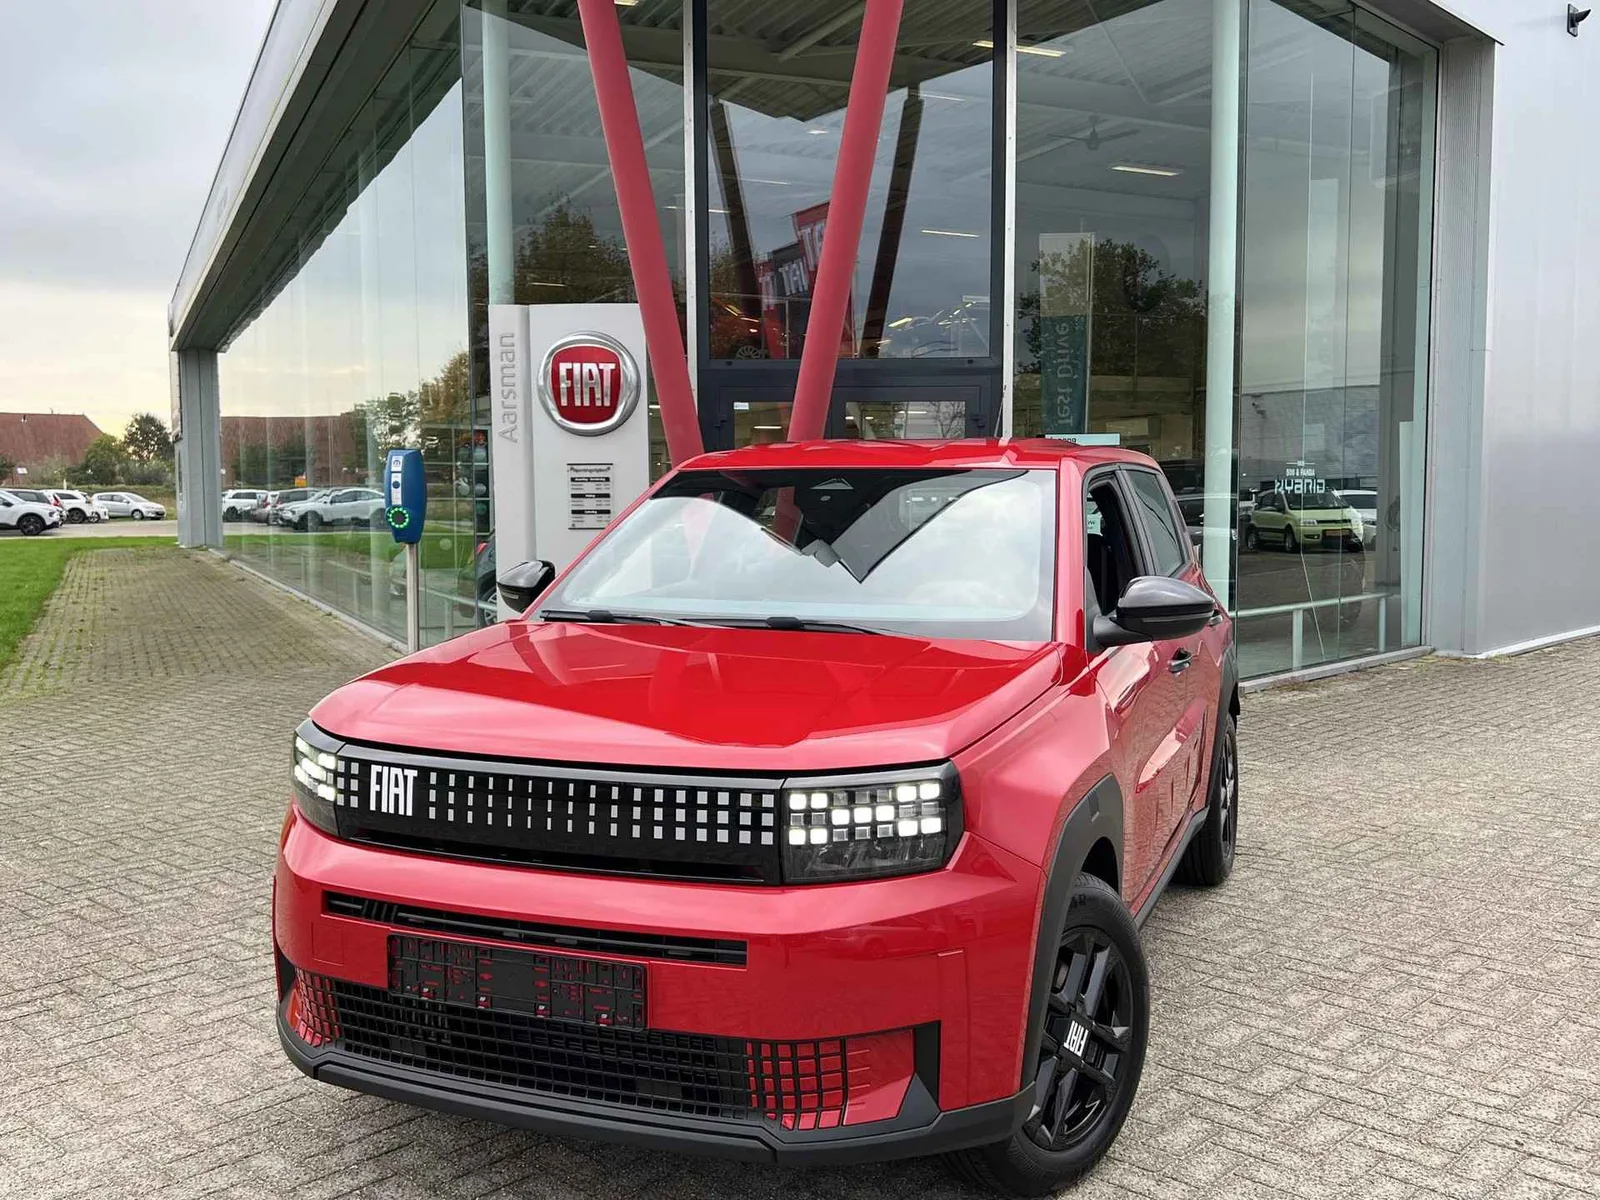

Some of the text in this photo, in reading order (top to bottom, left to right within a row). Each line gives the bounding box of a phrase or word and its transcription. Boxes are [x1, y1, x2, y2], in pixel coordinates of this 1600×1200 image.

[498, 332, 518, 443] Aarsman
[558, 362, 616, 407] FIAT
[369, 764, 418, 817] FIAT
[1063, 1019, 1089, 1058] FIAT
